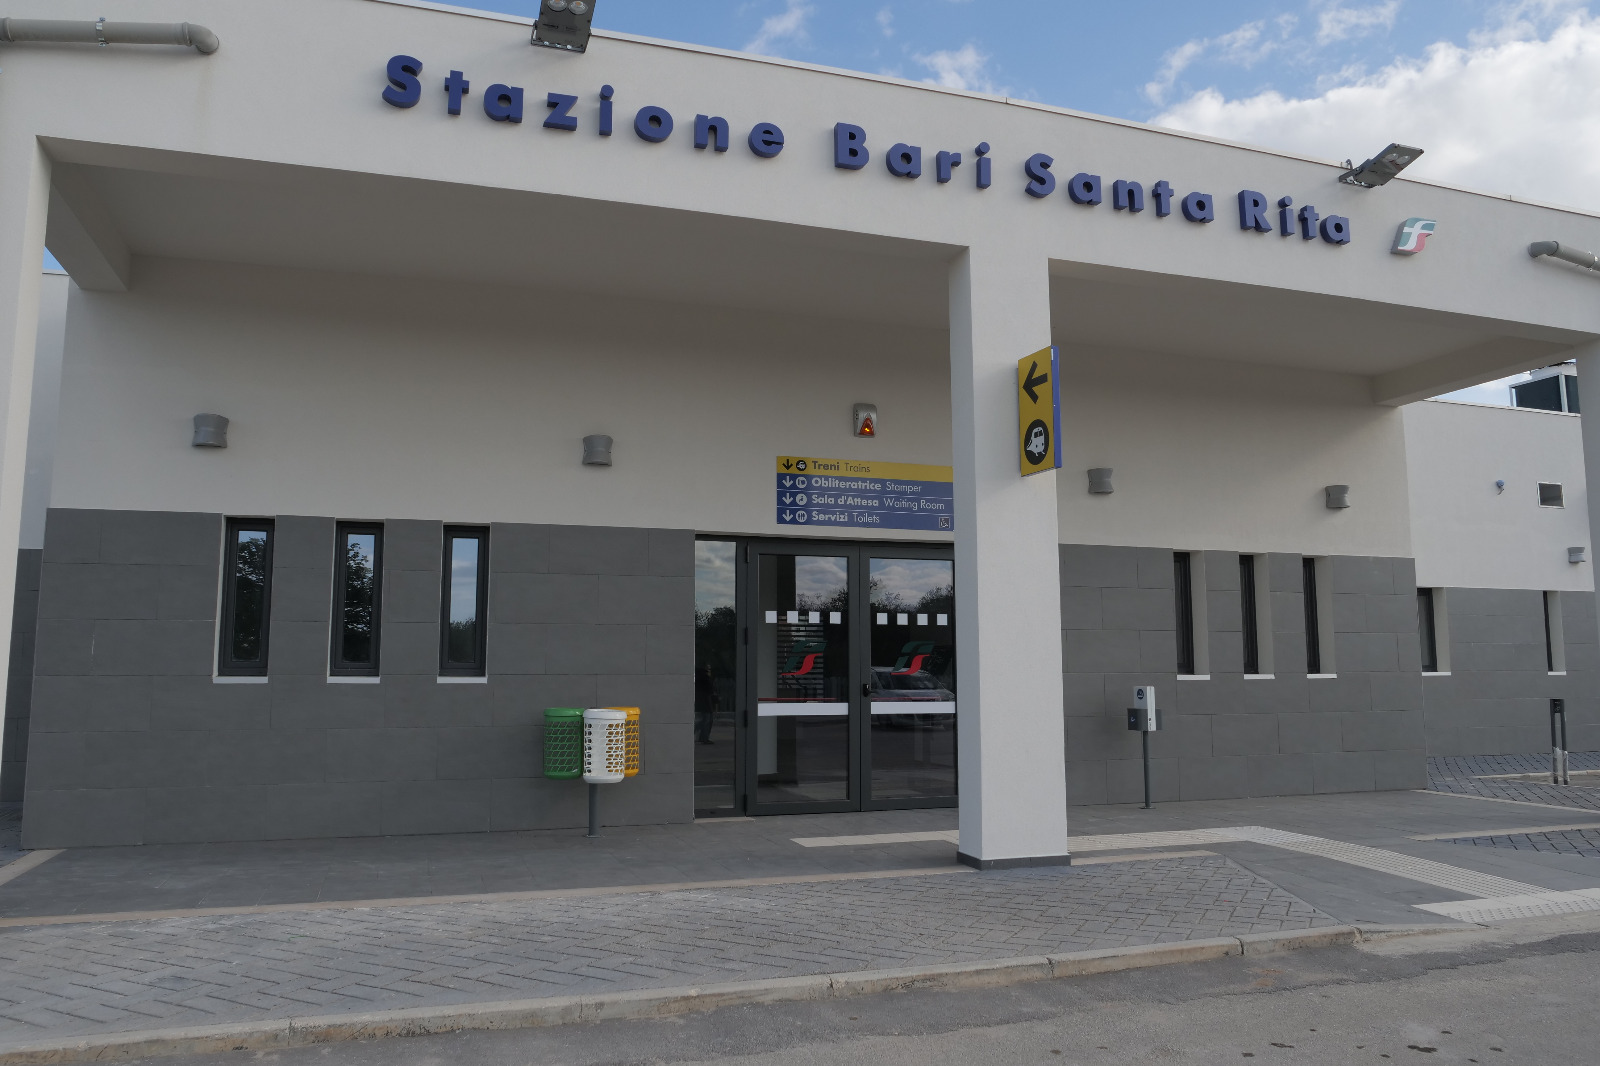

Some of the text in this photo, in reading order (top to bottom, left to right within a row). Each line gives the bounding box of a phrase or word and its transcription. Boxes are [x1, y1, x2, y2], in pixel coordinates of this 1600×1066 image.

[382, 54, 1352, 246] Stazione Bari Santa Rita
[811, 460, 871, 473] Treni Trains
[811, 477, 923, 494] Obliteratrice Stamper
[811, 494, 945, 511] Sala d'Attesa Waiting Room
[811, 511, 880, 523] Servizi Toilets
